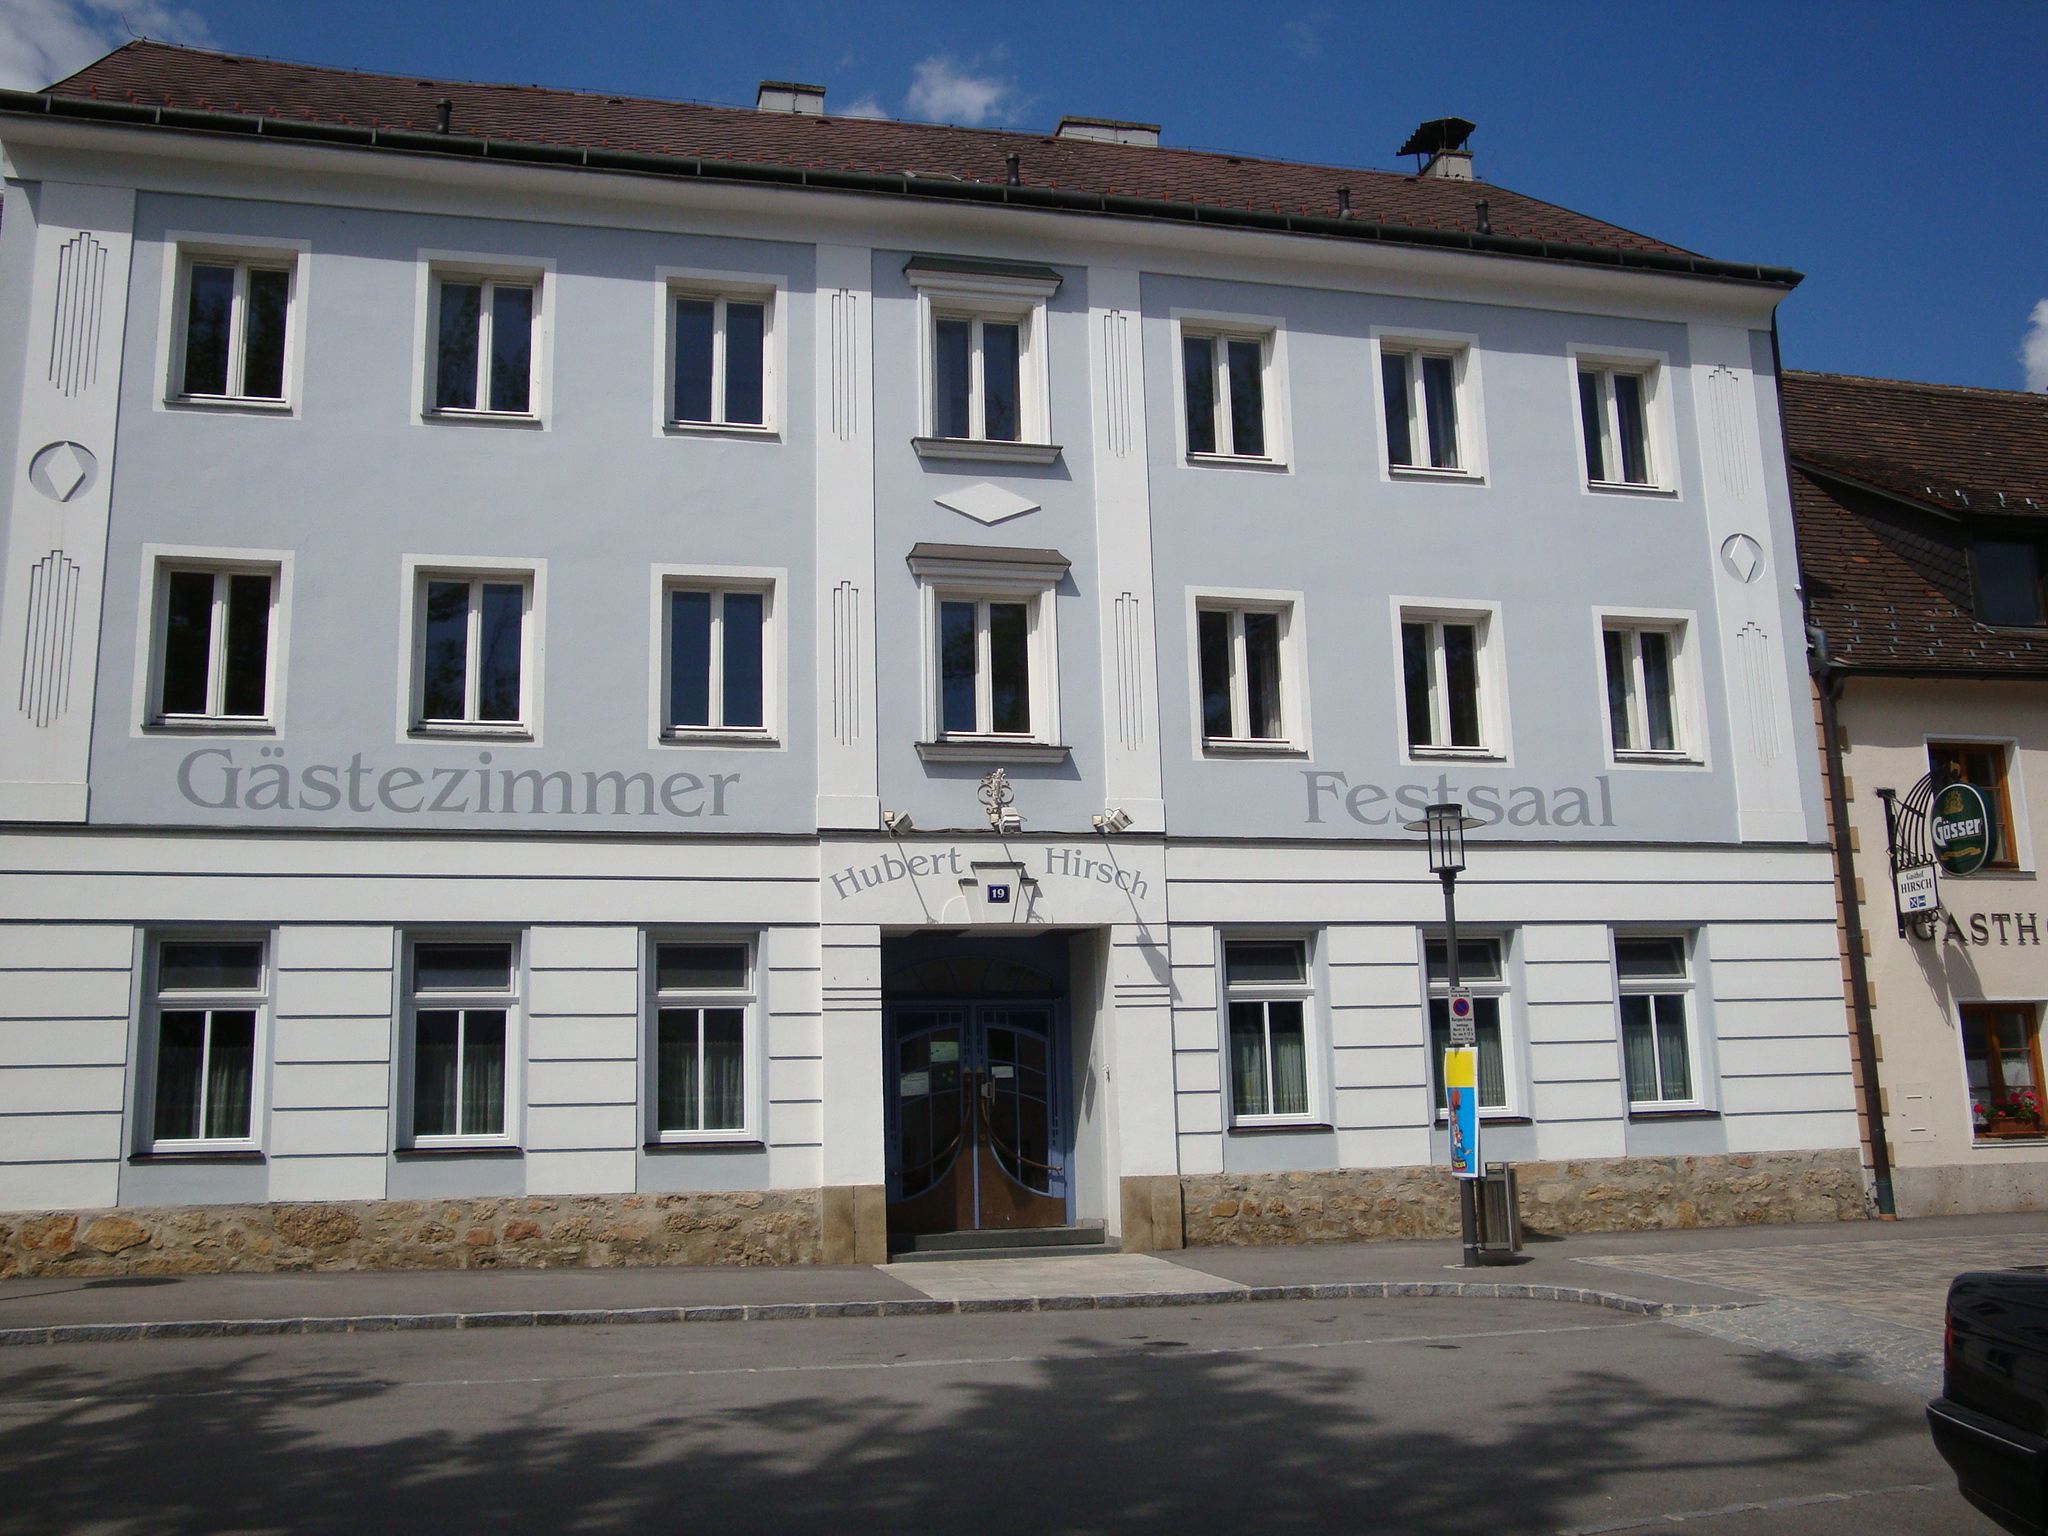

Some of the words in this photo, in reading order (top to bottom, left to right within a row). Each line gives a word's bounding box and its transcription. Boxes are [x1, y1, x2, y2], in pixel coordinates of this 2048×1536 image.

[176, 747, 741, 818] Gästezimmer
[1299, 770, 1617, 827] Festsaal
[1932, 816, 1981, 846] Gösser
[829, 846, 964, 900] Hubert
[1045, 847, 1149, 900] Hirsch
[1901, 879, 1932, 893] HIRSCH
[991, 888, 1005, 899] 19
[1913, 912, 2048, 944] GASTH
